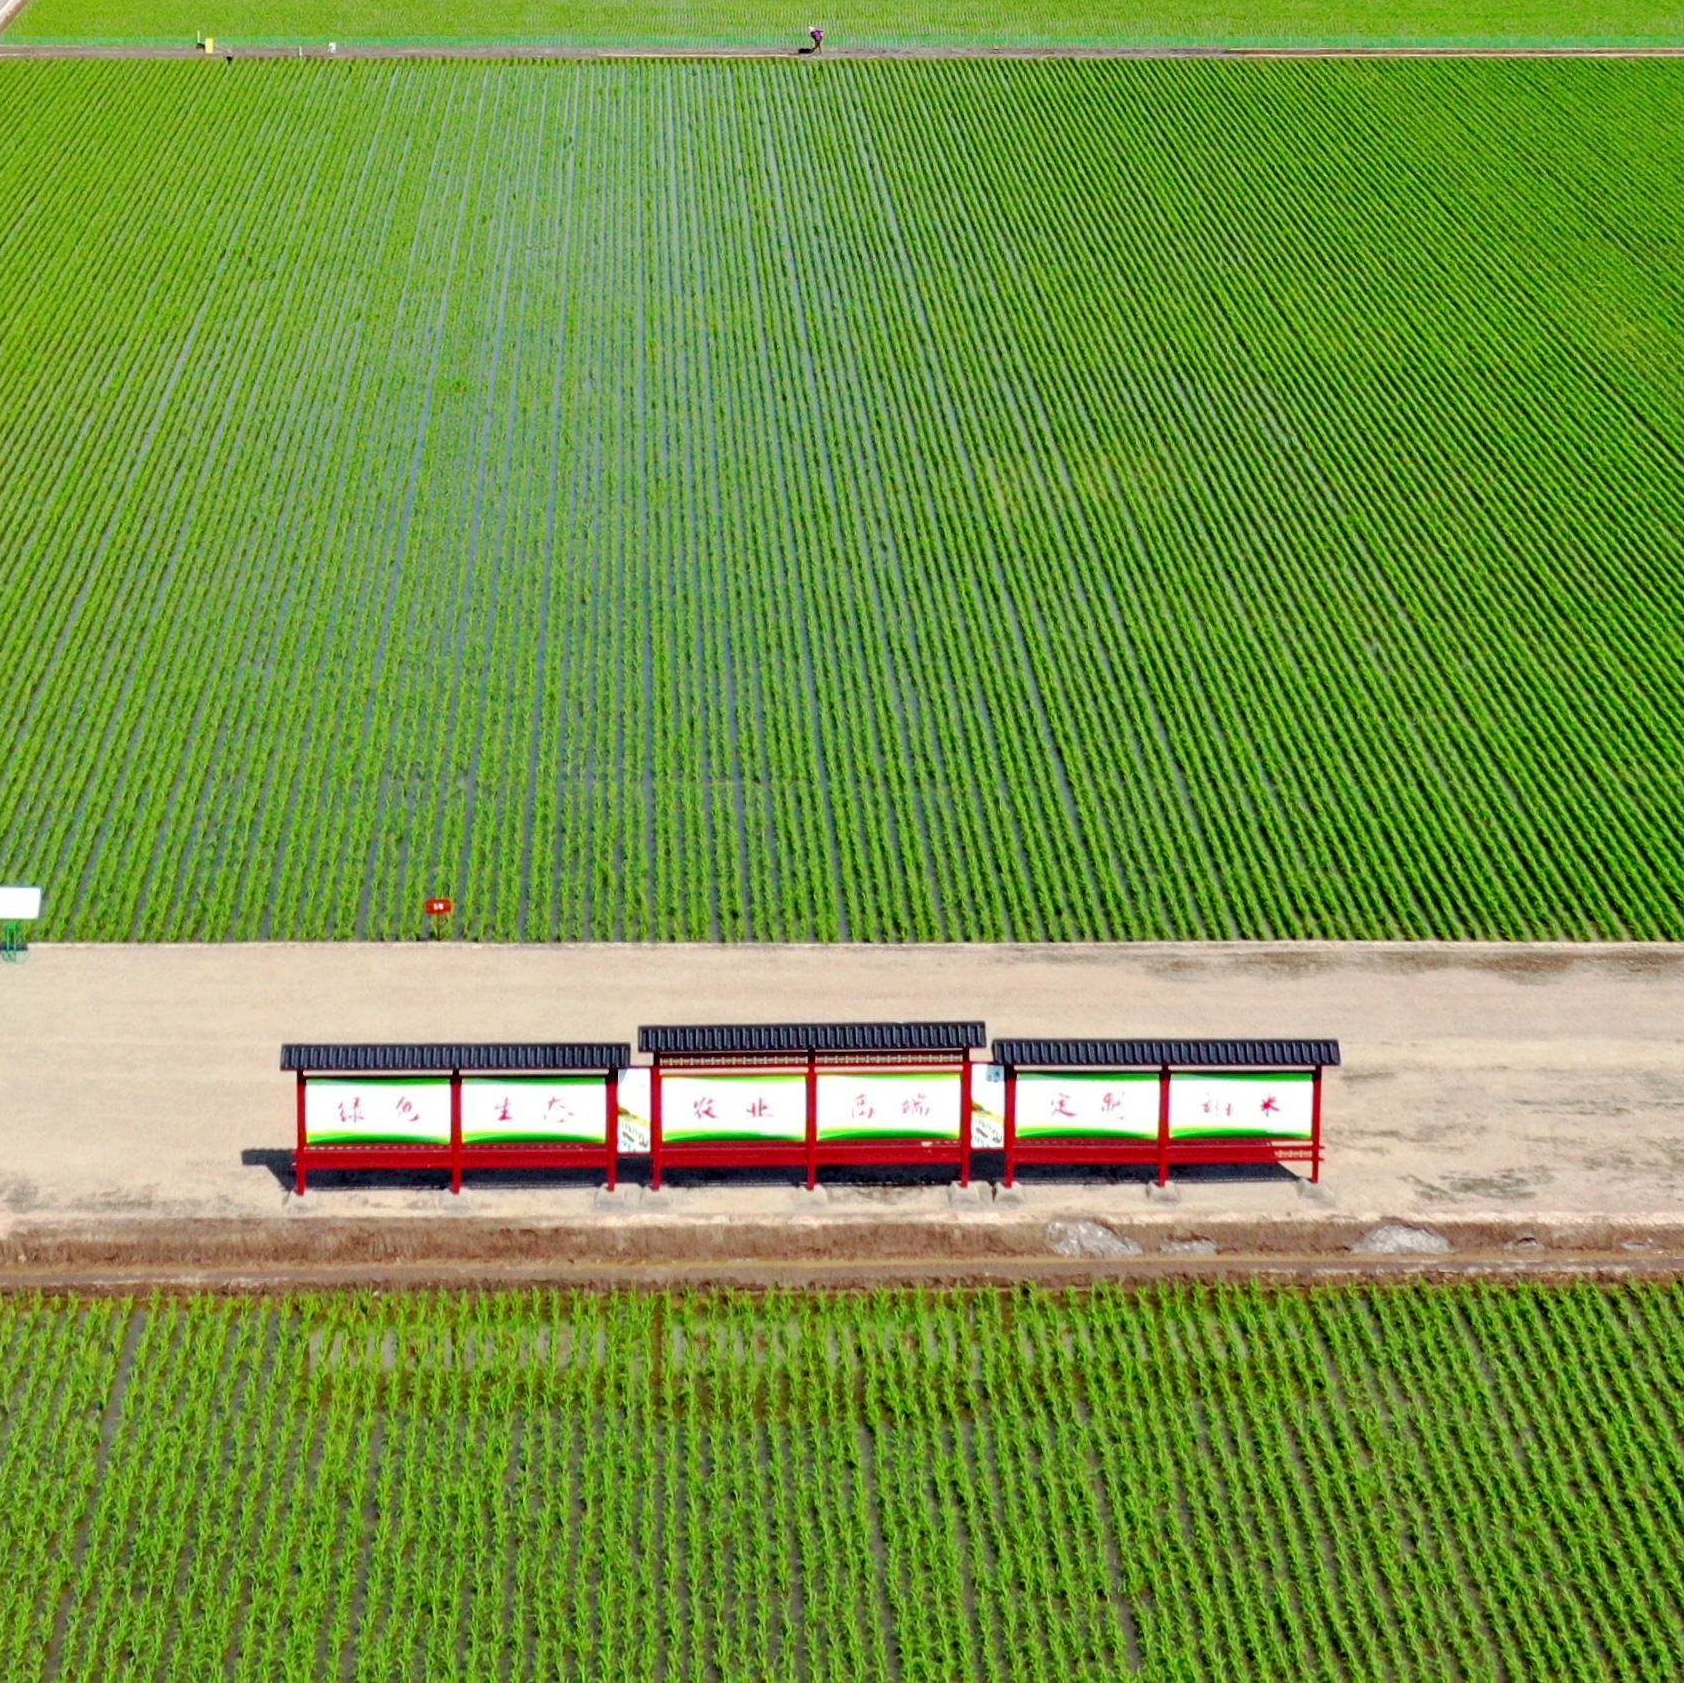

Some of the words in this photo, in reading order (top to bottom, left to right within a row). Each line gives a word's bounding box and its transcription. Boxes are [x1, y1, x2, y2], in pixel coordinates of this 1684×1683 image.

[336, 1094, 422, 1124] 绿色
[492, 1094, 575, 1124] 生态
[692, 1094, 773, 1120] 农业
